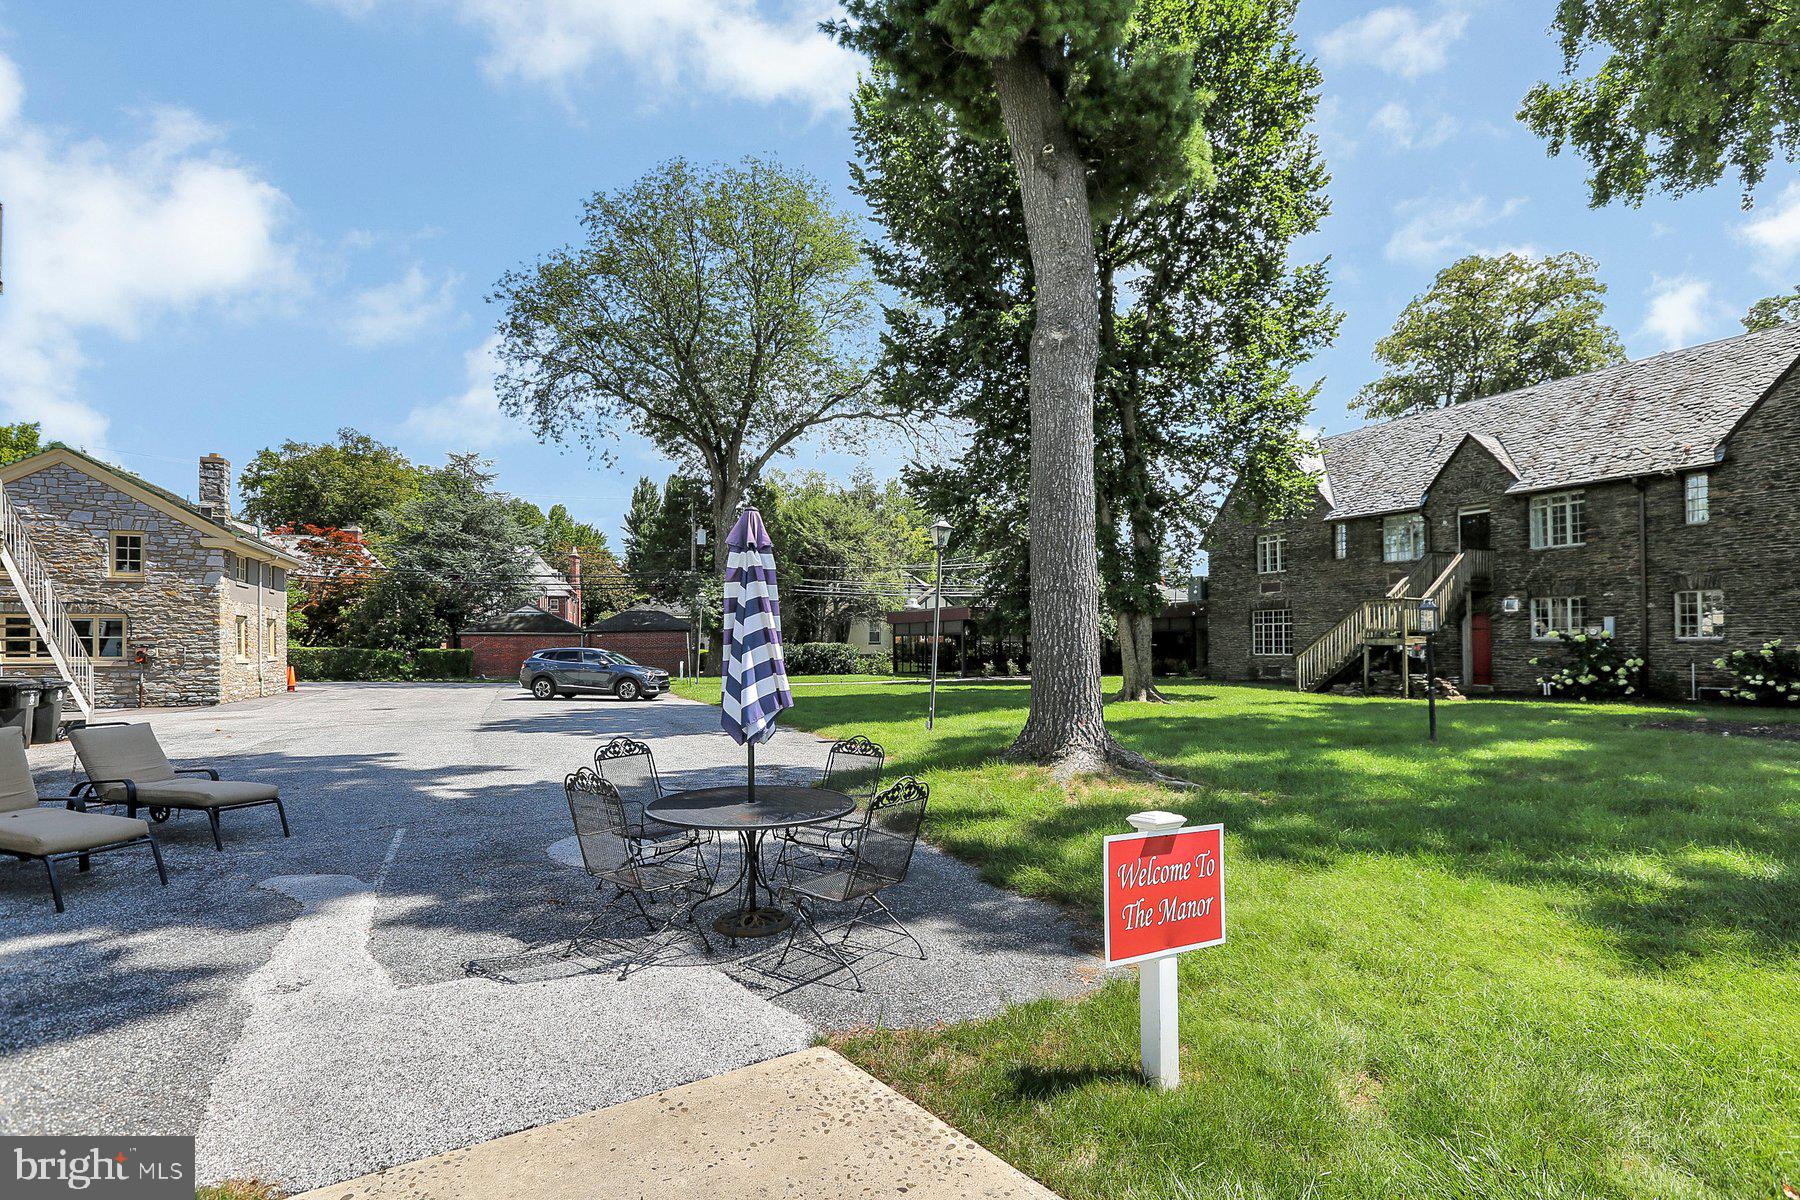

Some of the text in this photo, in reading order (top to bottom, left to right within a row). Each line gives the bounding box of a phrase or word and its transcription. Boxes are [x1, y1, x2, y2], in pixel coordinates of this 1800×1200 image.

[1117, 850, 1216, 890] Welcome To
[1121, 896, 1215, 931] The Manor
